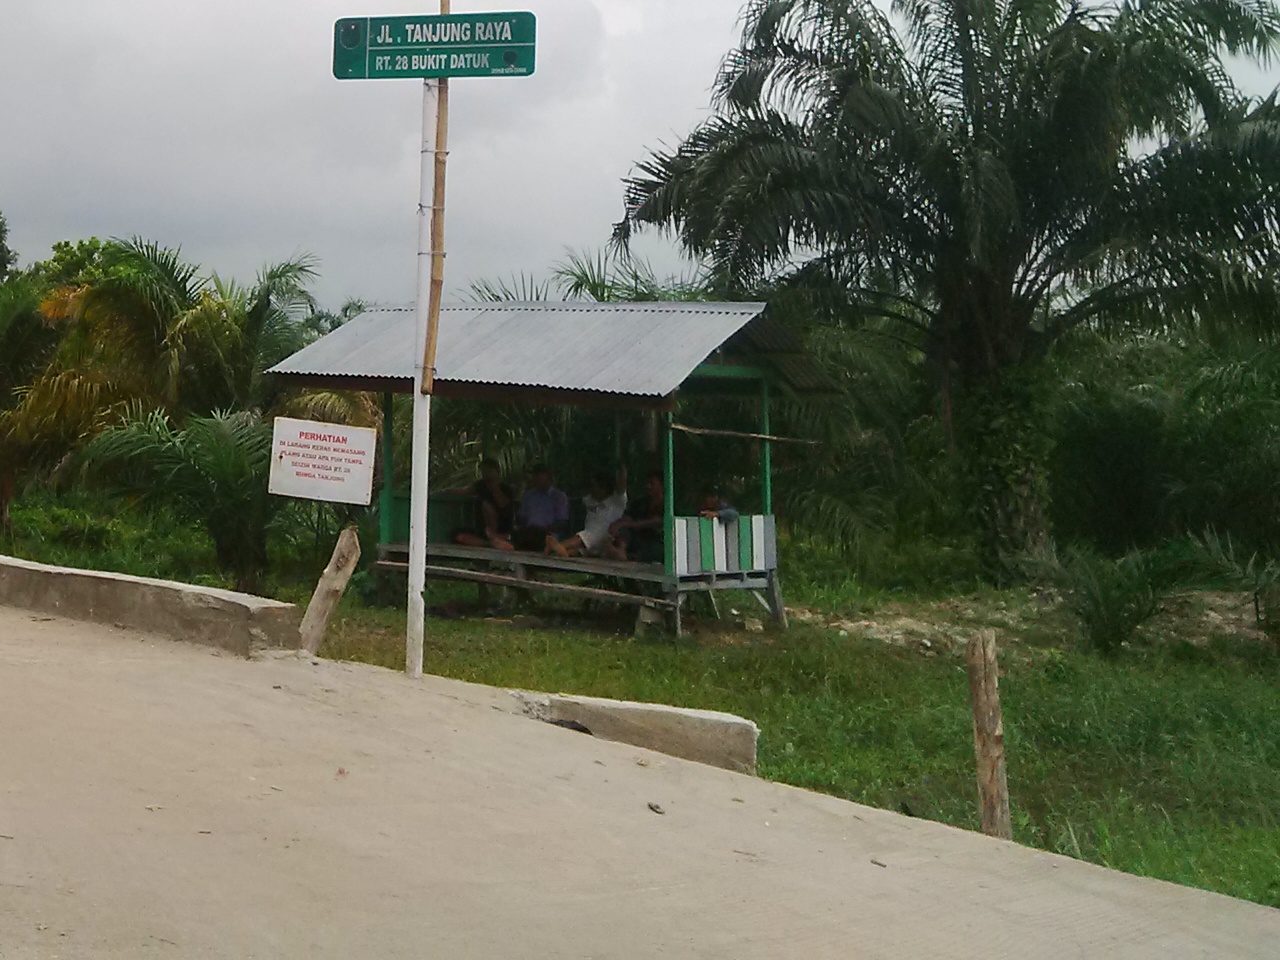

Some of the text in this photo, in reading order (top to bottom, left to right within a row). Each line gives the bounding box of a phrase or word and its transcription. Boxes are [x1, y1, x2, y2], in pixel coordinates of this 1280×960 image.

[405, 22, 470, 43] TANJUNG
[475, 21, 512, 41] RAYA
[375, 53, 490, 70] RT. 28 BUKIT DATUK
[299, 431, 348, 444] PERHATIAN
